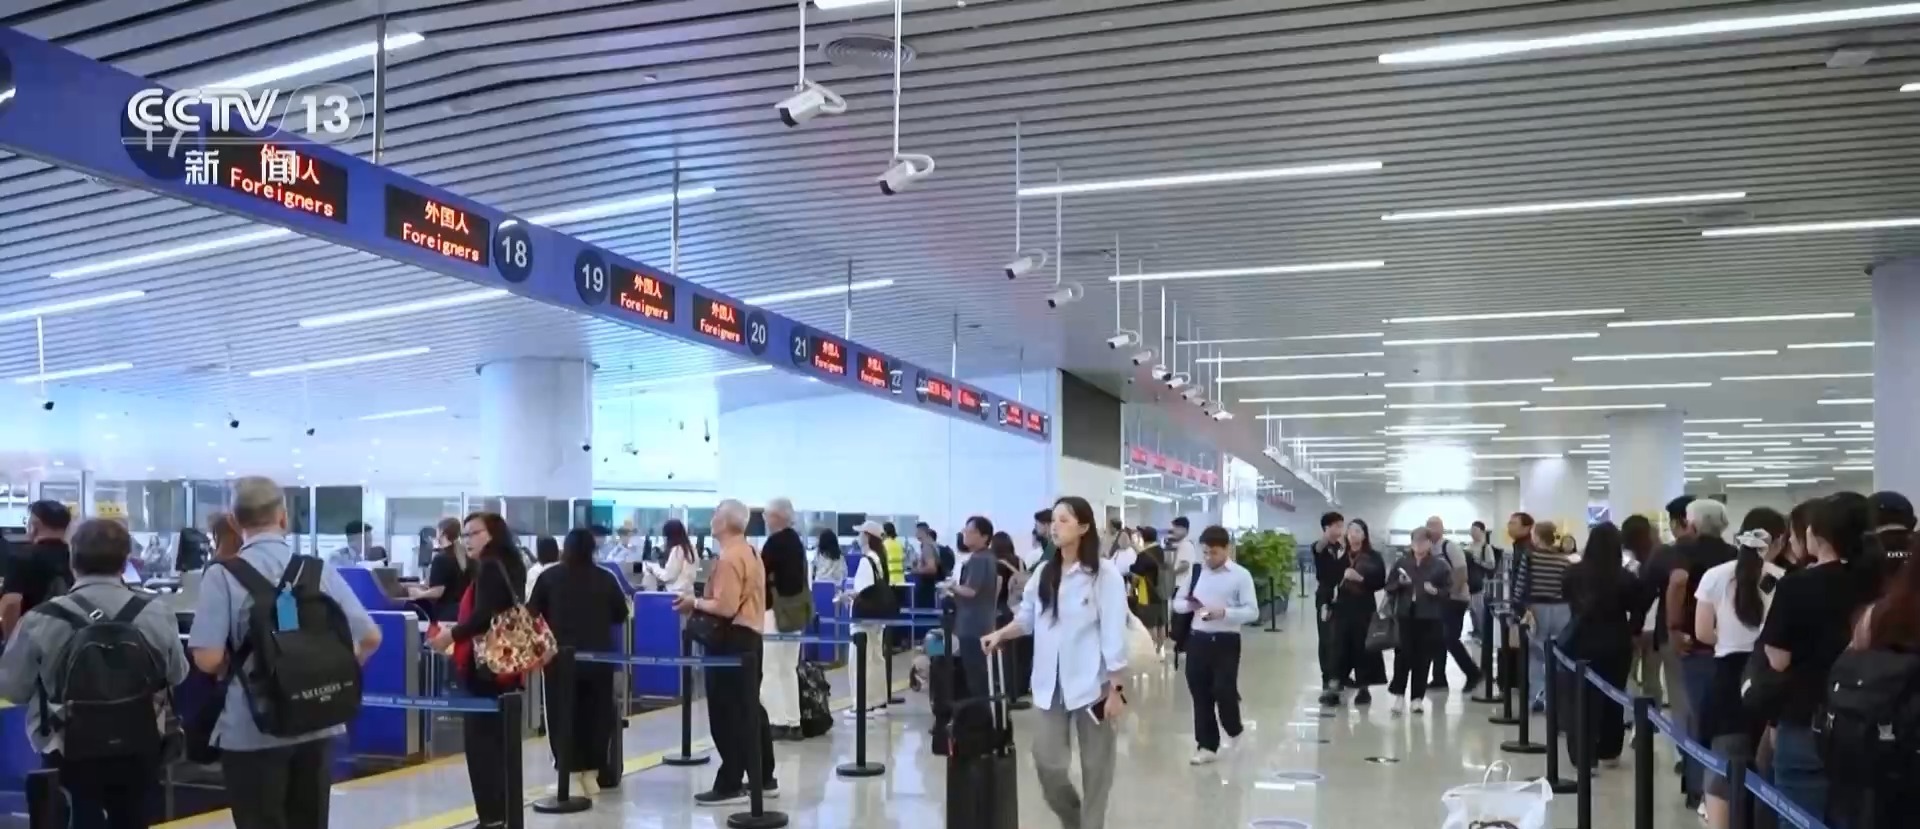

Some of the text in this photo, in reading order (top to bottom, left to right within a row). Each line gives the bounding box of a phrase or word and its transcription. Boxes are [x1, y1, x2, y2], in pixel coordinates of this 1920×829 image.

[260, 144, 320, 185] 外人
[230, 168, 334, 218] Foreigners
[424, 200, 470, 235] 外国人
[402, 222, 480, 262] Foreigners
[501, 236, 528, 268] 18
[581, 263, 604, 292] 19
[633, 273, 663, 299] 外国人
[620, 295, 669, 321] Foreigners
[711, 301, 735, 324] 外国人
[700, 318, 741, 343] Foreigners
[751, 321, 766, 345] 20
[794, 336, 807, 358] 21
